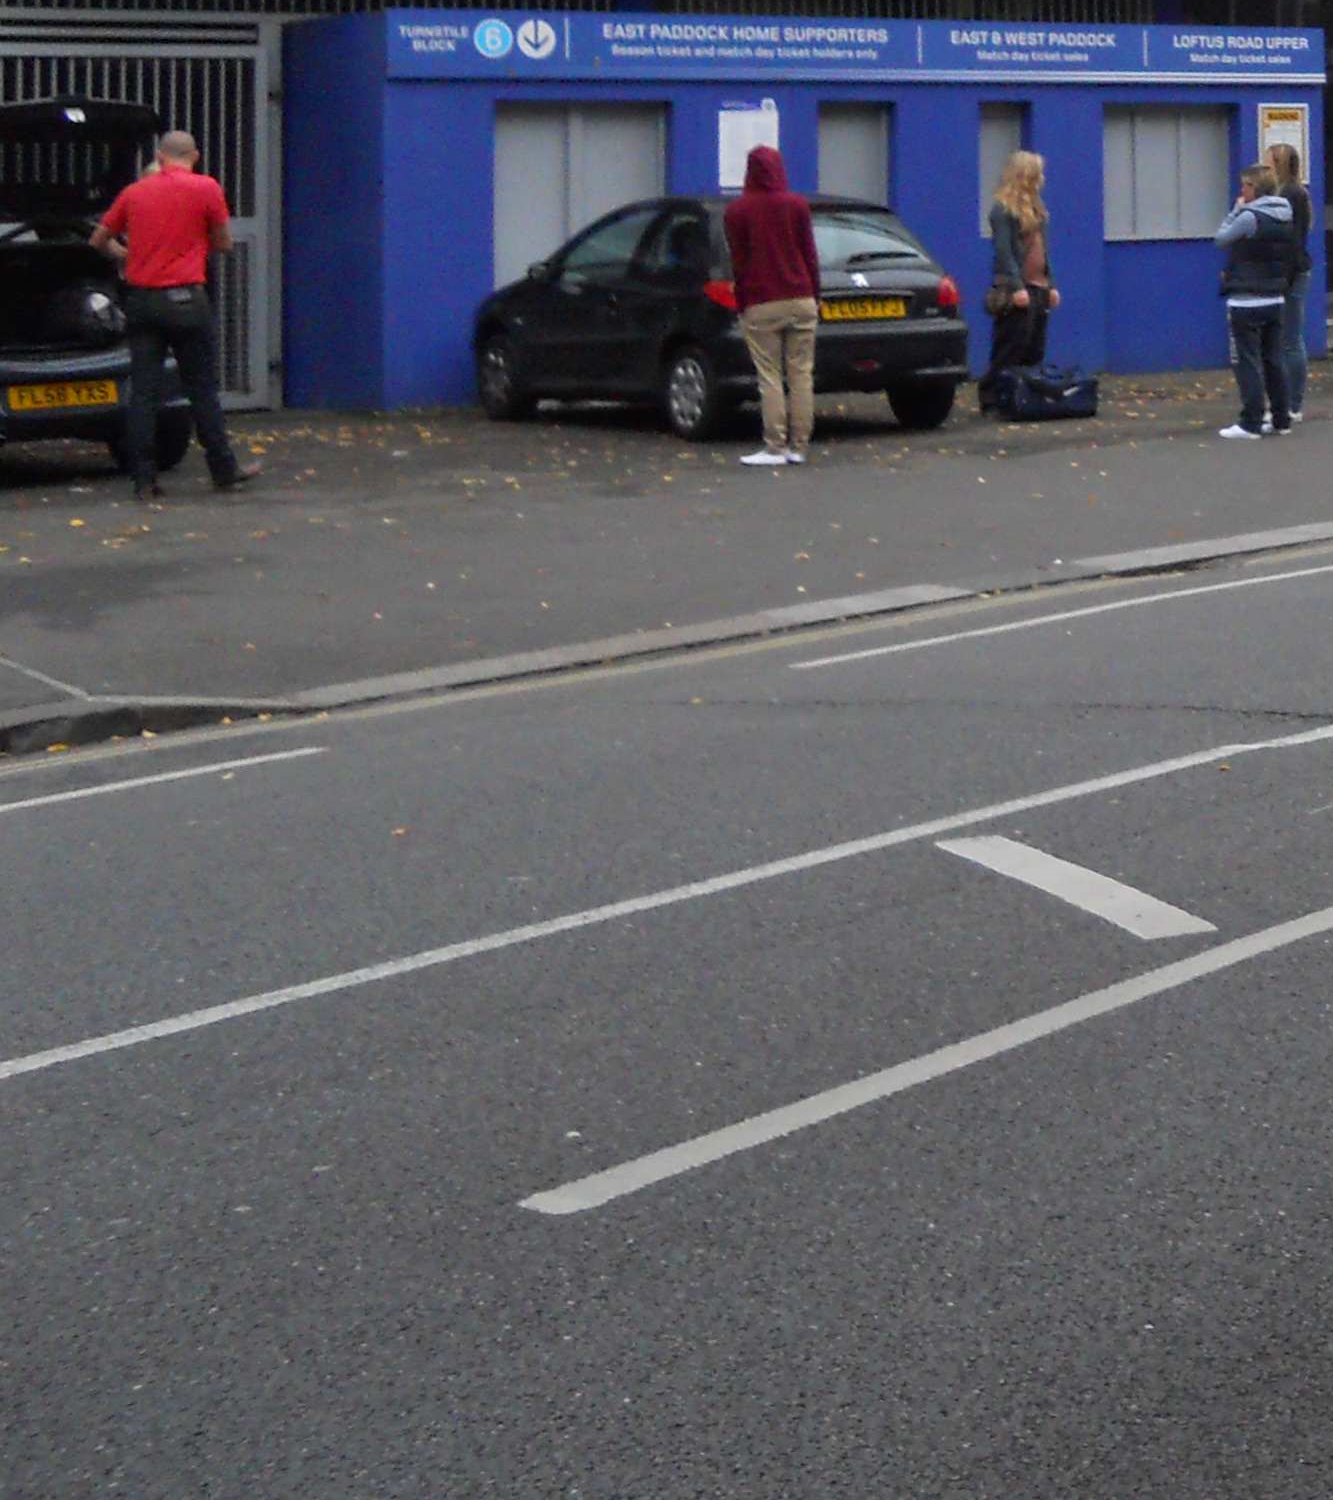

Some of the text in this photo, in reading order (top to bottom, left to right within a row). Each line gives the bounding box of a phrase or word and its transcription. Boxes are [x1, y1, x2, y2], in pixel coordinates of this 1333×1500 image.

[399, 24, 470, 39] TURNSTILE
[485, 27, 502, 50] 6
[603, 23, 889, 43] EAST PADDOCK HOME SUPPORTERS
[951, 30, 988, 45] EAST
[1004, 31, 1045, 46] WEST
[1048, 33, 1117, 48] PADDOCK
[412, 39, 456, 52] BLOCK
[1173, 35, 1309, 50] LOFTUS ROAD UPPER
[658, 45, 692, 57] ticket
[694, 45, 715, 57] and
[756, 47, 775, 60] day
[778, 47, 810, 59] ticket
[977, 50, 1009, 61] Match
[1011, 52, 1029, 64] day
[1032, 51, 1061, 62] ticket
[1190, 53, 1291, 66] Match day ticket sales
